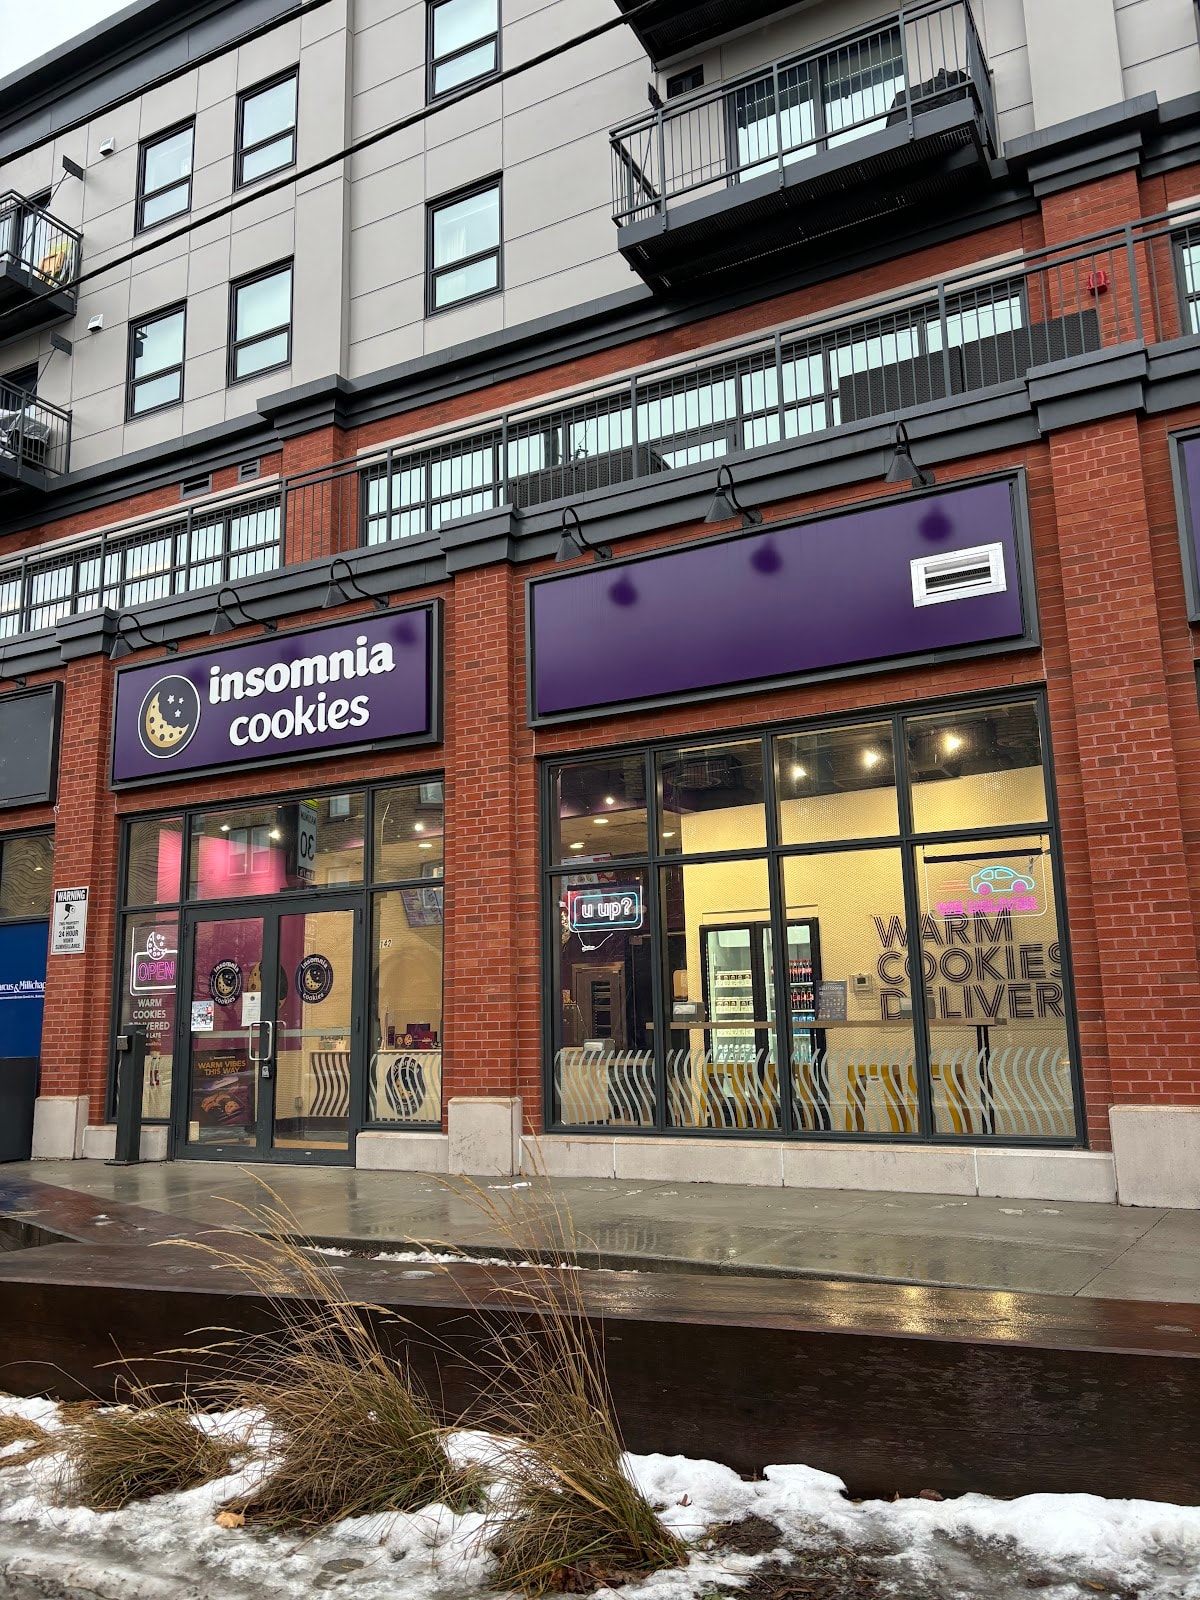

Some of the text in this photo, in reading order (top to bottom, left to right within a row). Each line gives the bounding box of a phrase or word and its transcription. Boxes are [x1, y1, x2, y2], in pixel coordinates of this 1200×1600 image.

[209, 635, 396, 705] insomnia
[229, 692, 370, 746] cookies
[57, 890, 86, 902] WARNING
[582, 897, 633, 920] u up?
[967, 896, 1038, 914] DELIVER
[874, 907, 1013, 948] WARM
[213, 961, 240, 973] insomnia
[301, 957, 328, 969] insomnia
[138, 961, 175, 981] OPEN
[14, 983, 20, 993] &
[138, 998, 162, 1007] WARM
[215, 996, 236, 1004] cookies
[302, 992, 324, 1001] cookies
[880, 982, 1064, 1020] DLIVER
[133, 1010, 166, 1020] COOKIES
[198, 1061, 223, 1069] WARM
[204, 1068, 221, 1076] THIS
